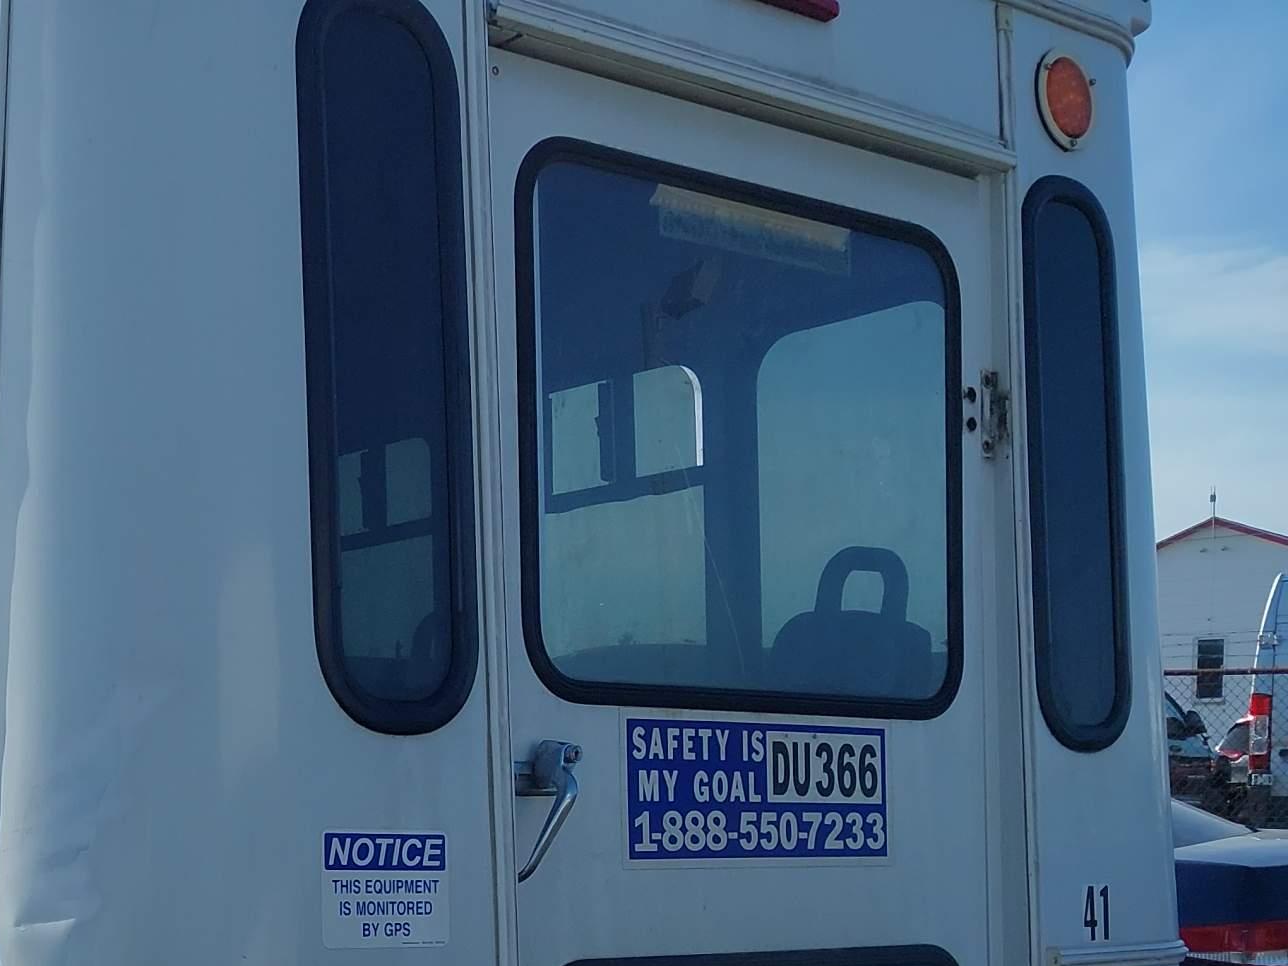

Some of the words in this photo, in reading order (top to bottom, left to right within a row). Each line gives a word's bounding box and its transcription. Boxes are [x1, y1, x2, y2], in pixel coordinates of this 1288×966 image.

[632, 726, 730, 761] SAFETY
[742, 730, 764, 762] IS
[638, 769, 679, 802] MY
[693, 770, 761, 802] GOAL
[771, 740, 878, 798] DU366
[634, 810, 885, 852] 1-888-550-7233
[328, 837, 443, 867] NOTICE
[332, 879, 361, 894] THIS
[365, 879, 439, 895] EQUIPMENT
[339, 900, 352, 916] IS
[356, 900, 433, 916] MONITORED
[1083, 884, 1110, 941] 41
[362, 922, 380, 937] BY
[384, 921, 411, 937] GPS
